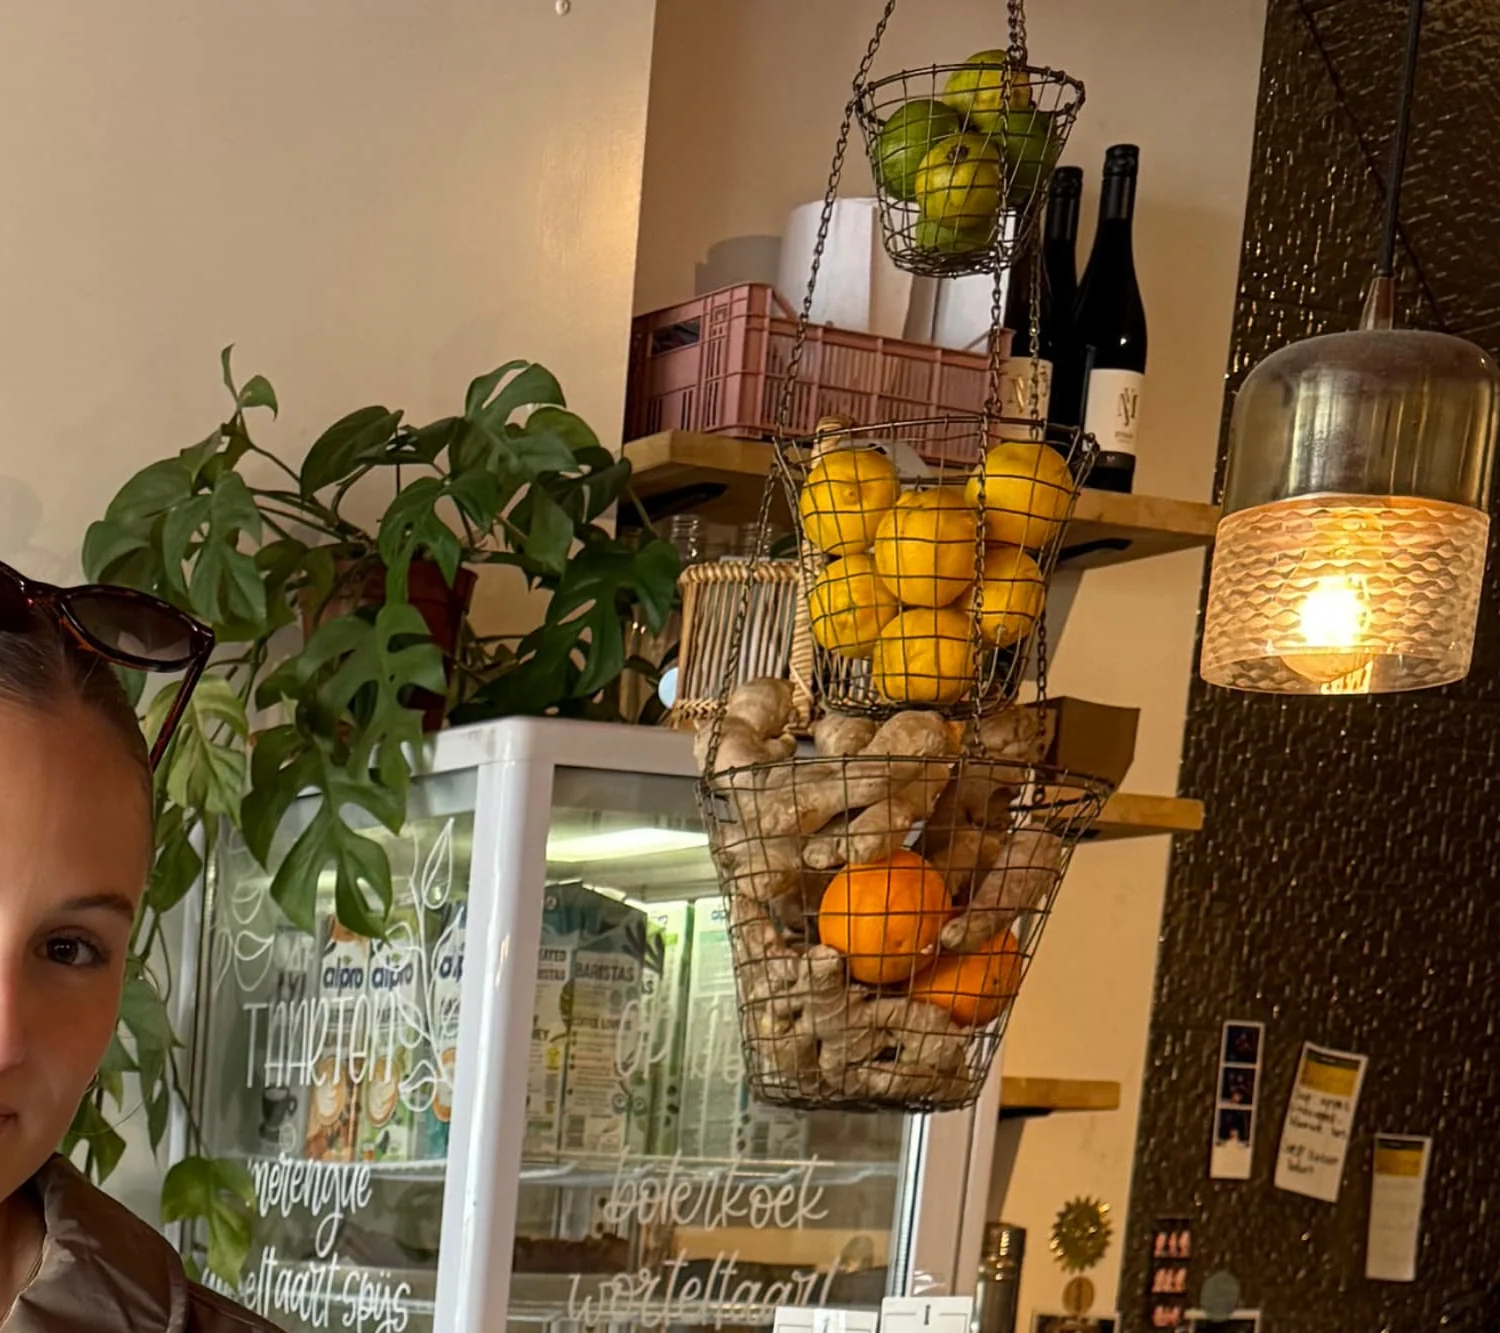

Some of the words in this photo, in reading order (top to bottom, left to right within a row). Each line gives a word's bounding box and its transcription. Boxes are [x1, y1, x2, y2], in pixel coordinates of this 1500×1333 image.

[323, 957, 364, 994] alpro
[371, 958, 414, 992] alpro
[602, 1146, 830, 1232] boterkoek
